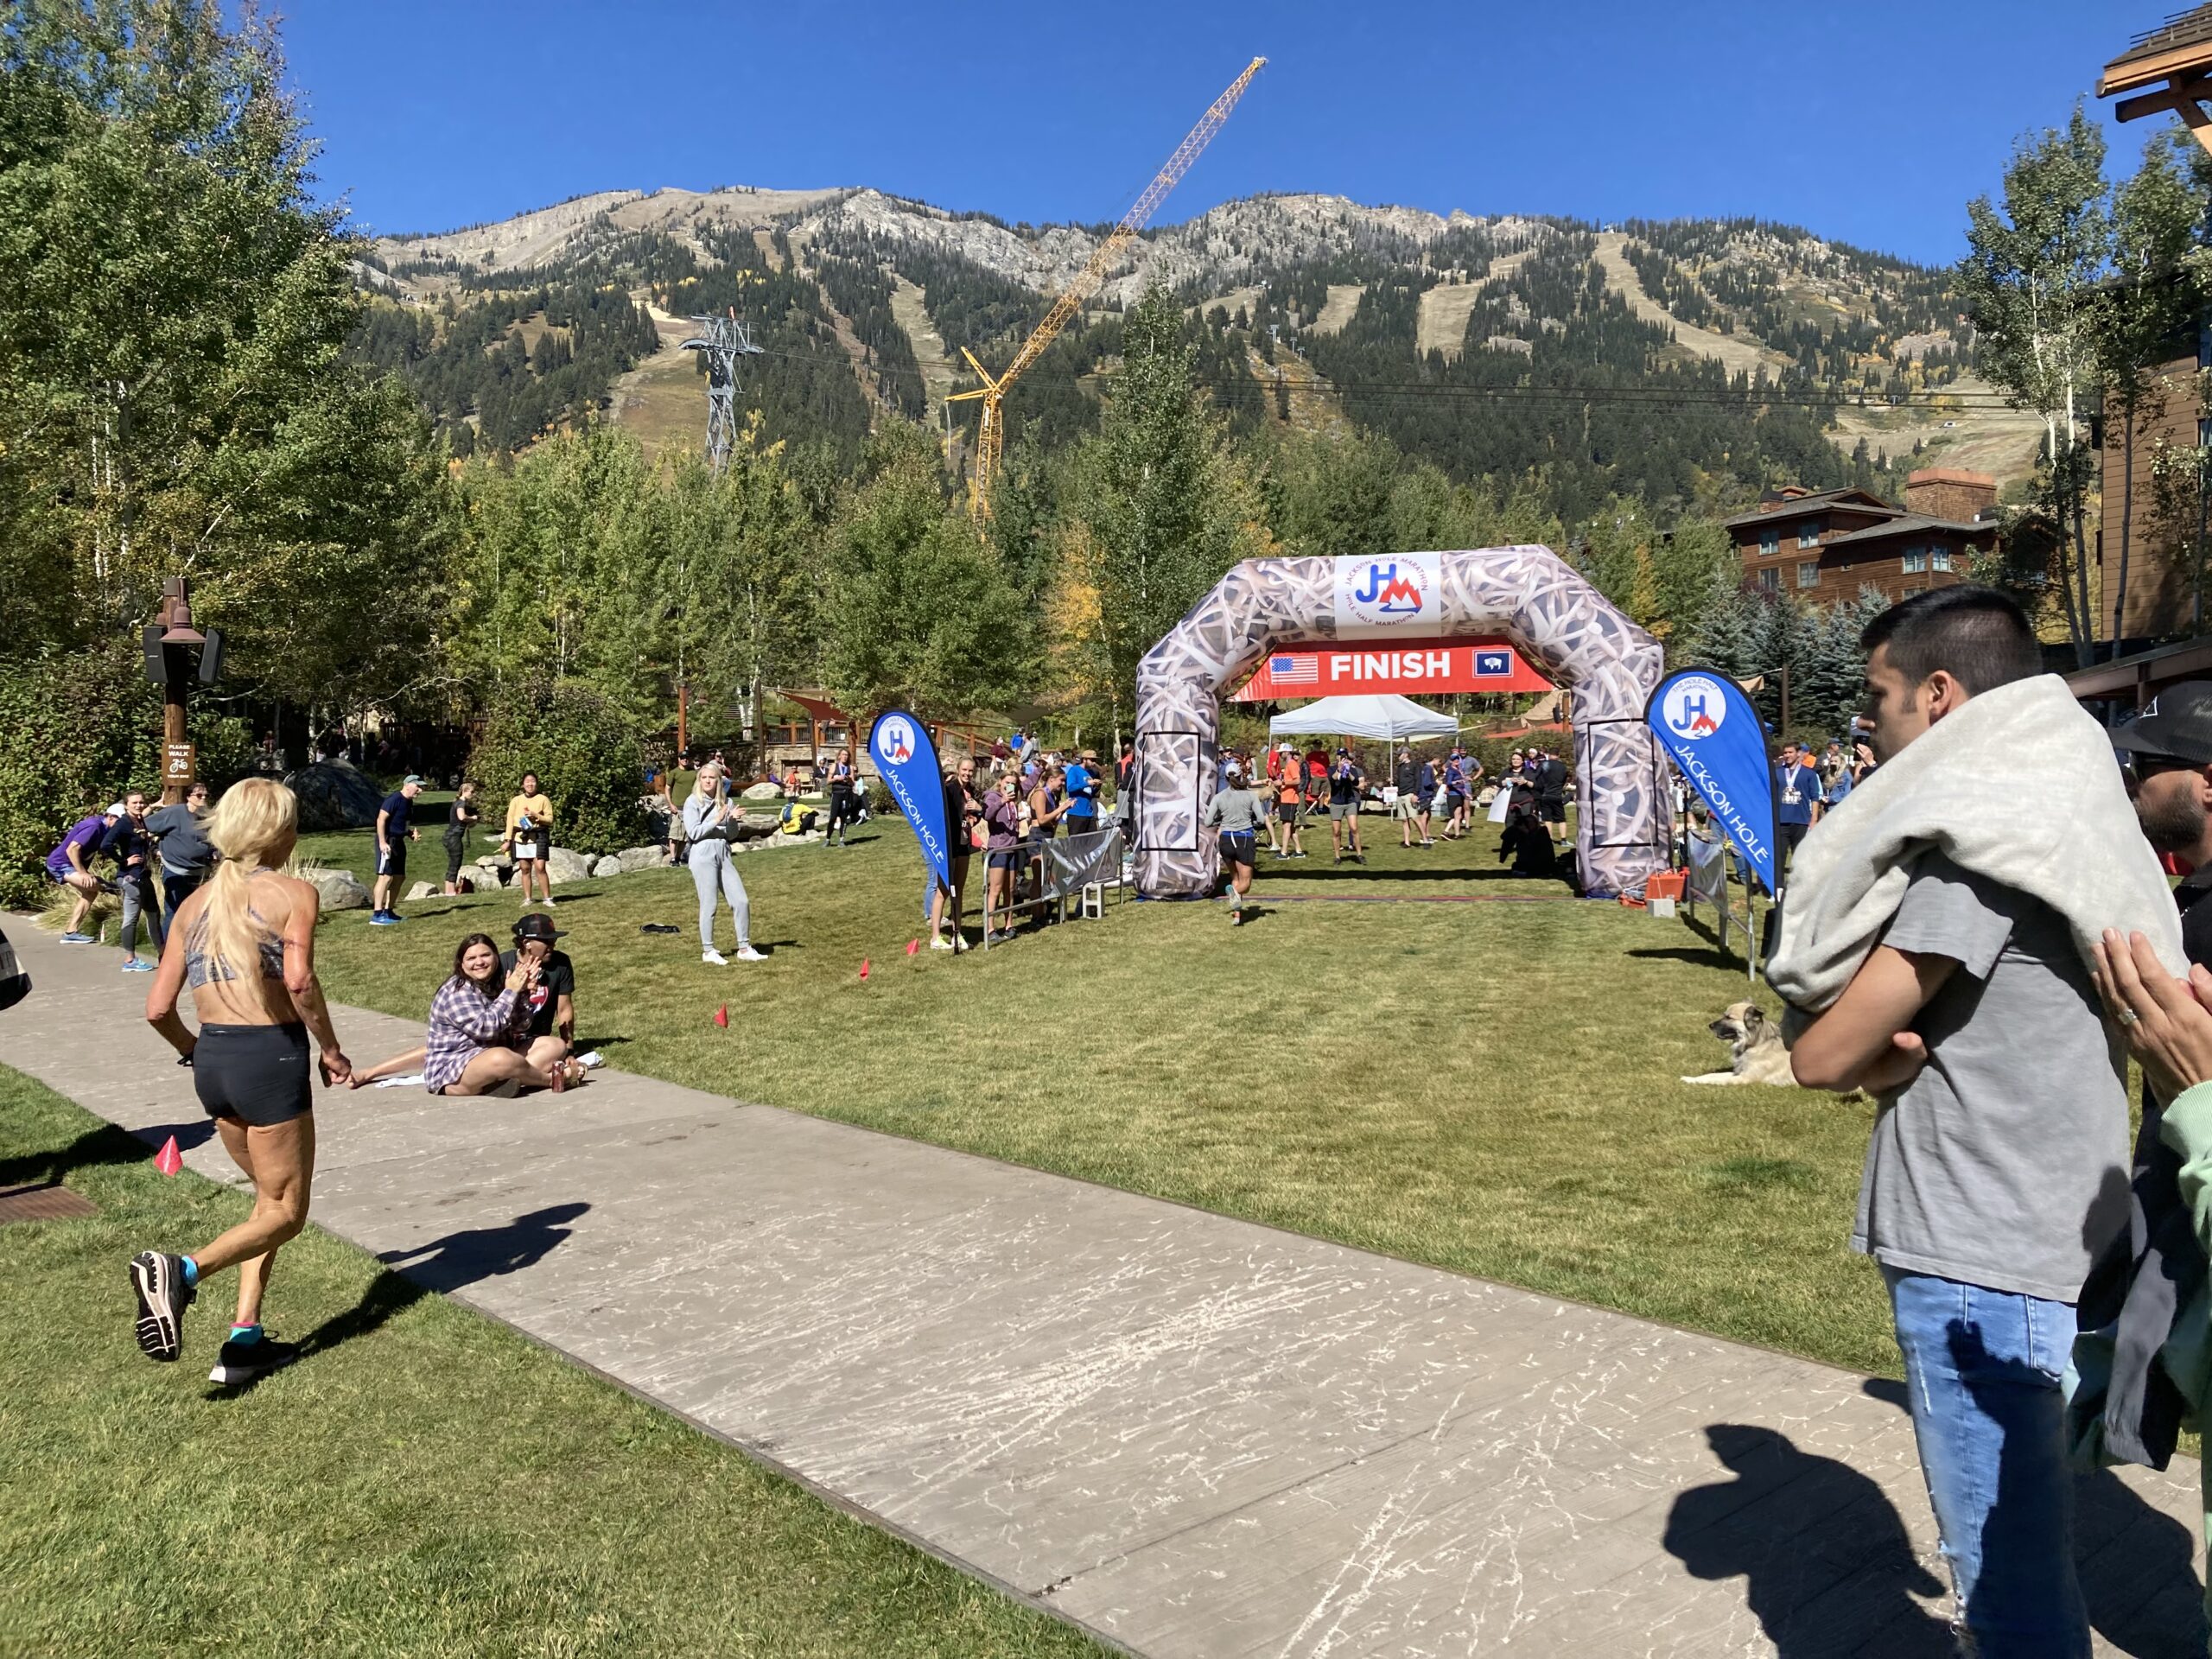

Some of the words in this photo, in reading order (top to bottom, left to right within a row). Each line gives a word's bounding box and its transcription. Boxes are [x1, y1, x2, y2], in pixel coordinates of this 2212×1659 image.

[1345, 560, 1372, 586] JACKSON
[1400, 557, 1428, 591] MARATHON
[1355, 612, 1373, 623] HALF
[1375, 613, 1414, 626] MARATHON
[1331, 652, 1451, 681] FINISH
[886, 769, 923, 825] JACKSON
[919, 824, 944, 864] HOLE
[1675, 745, 1735, 816] JACKSON
[1729, 815, 1769, 864] HOLE
